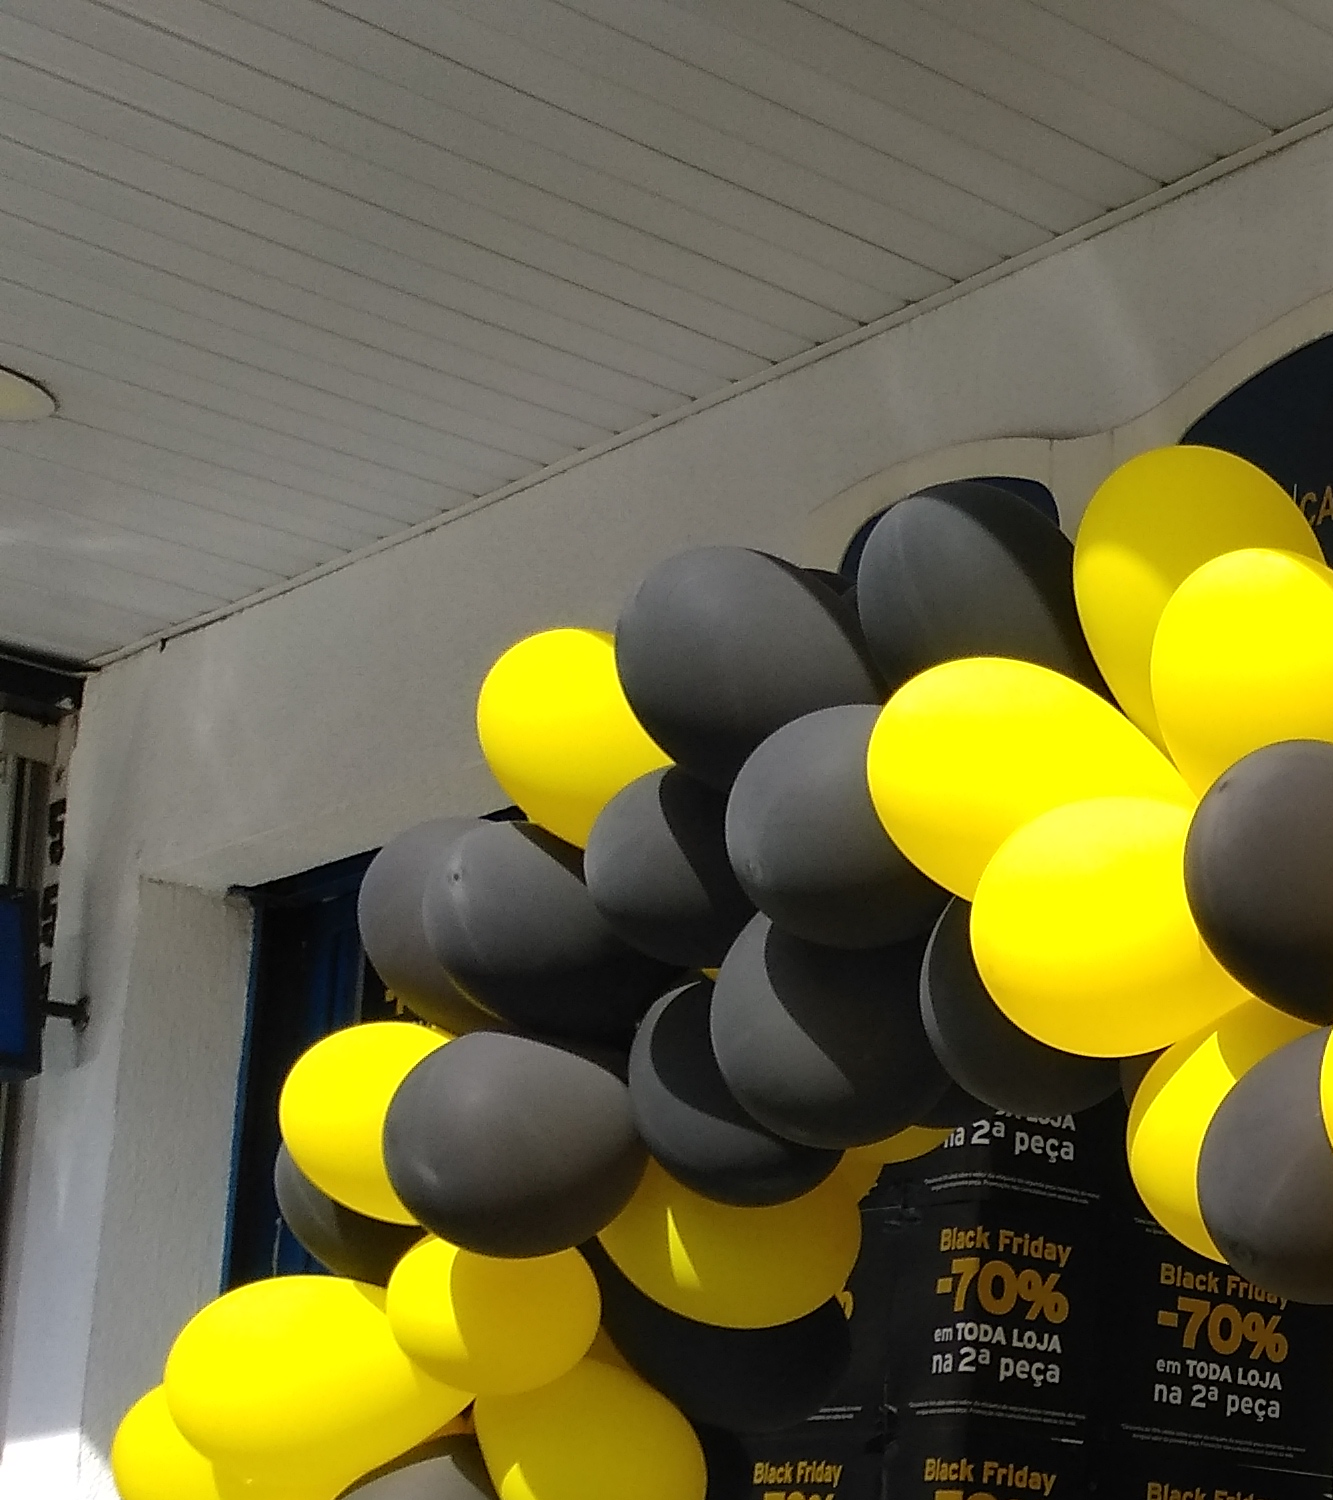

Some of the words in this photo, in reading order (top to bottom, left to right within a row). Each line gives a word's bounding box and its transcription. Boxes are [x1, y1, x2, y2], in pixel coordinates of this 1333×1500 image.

[1014, 1130, 1075, 1164] peça
[753, 1461, 792, 1485] Black
[796, 1460, 843, 1488] Friday
